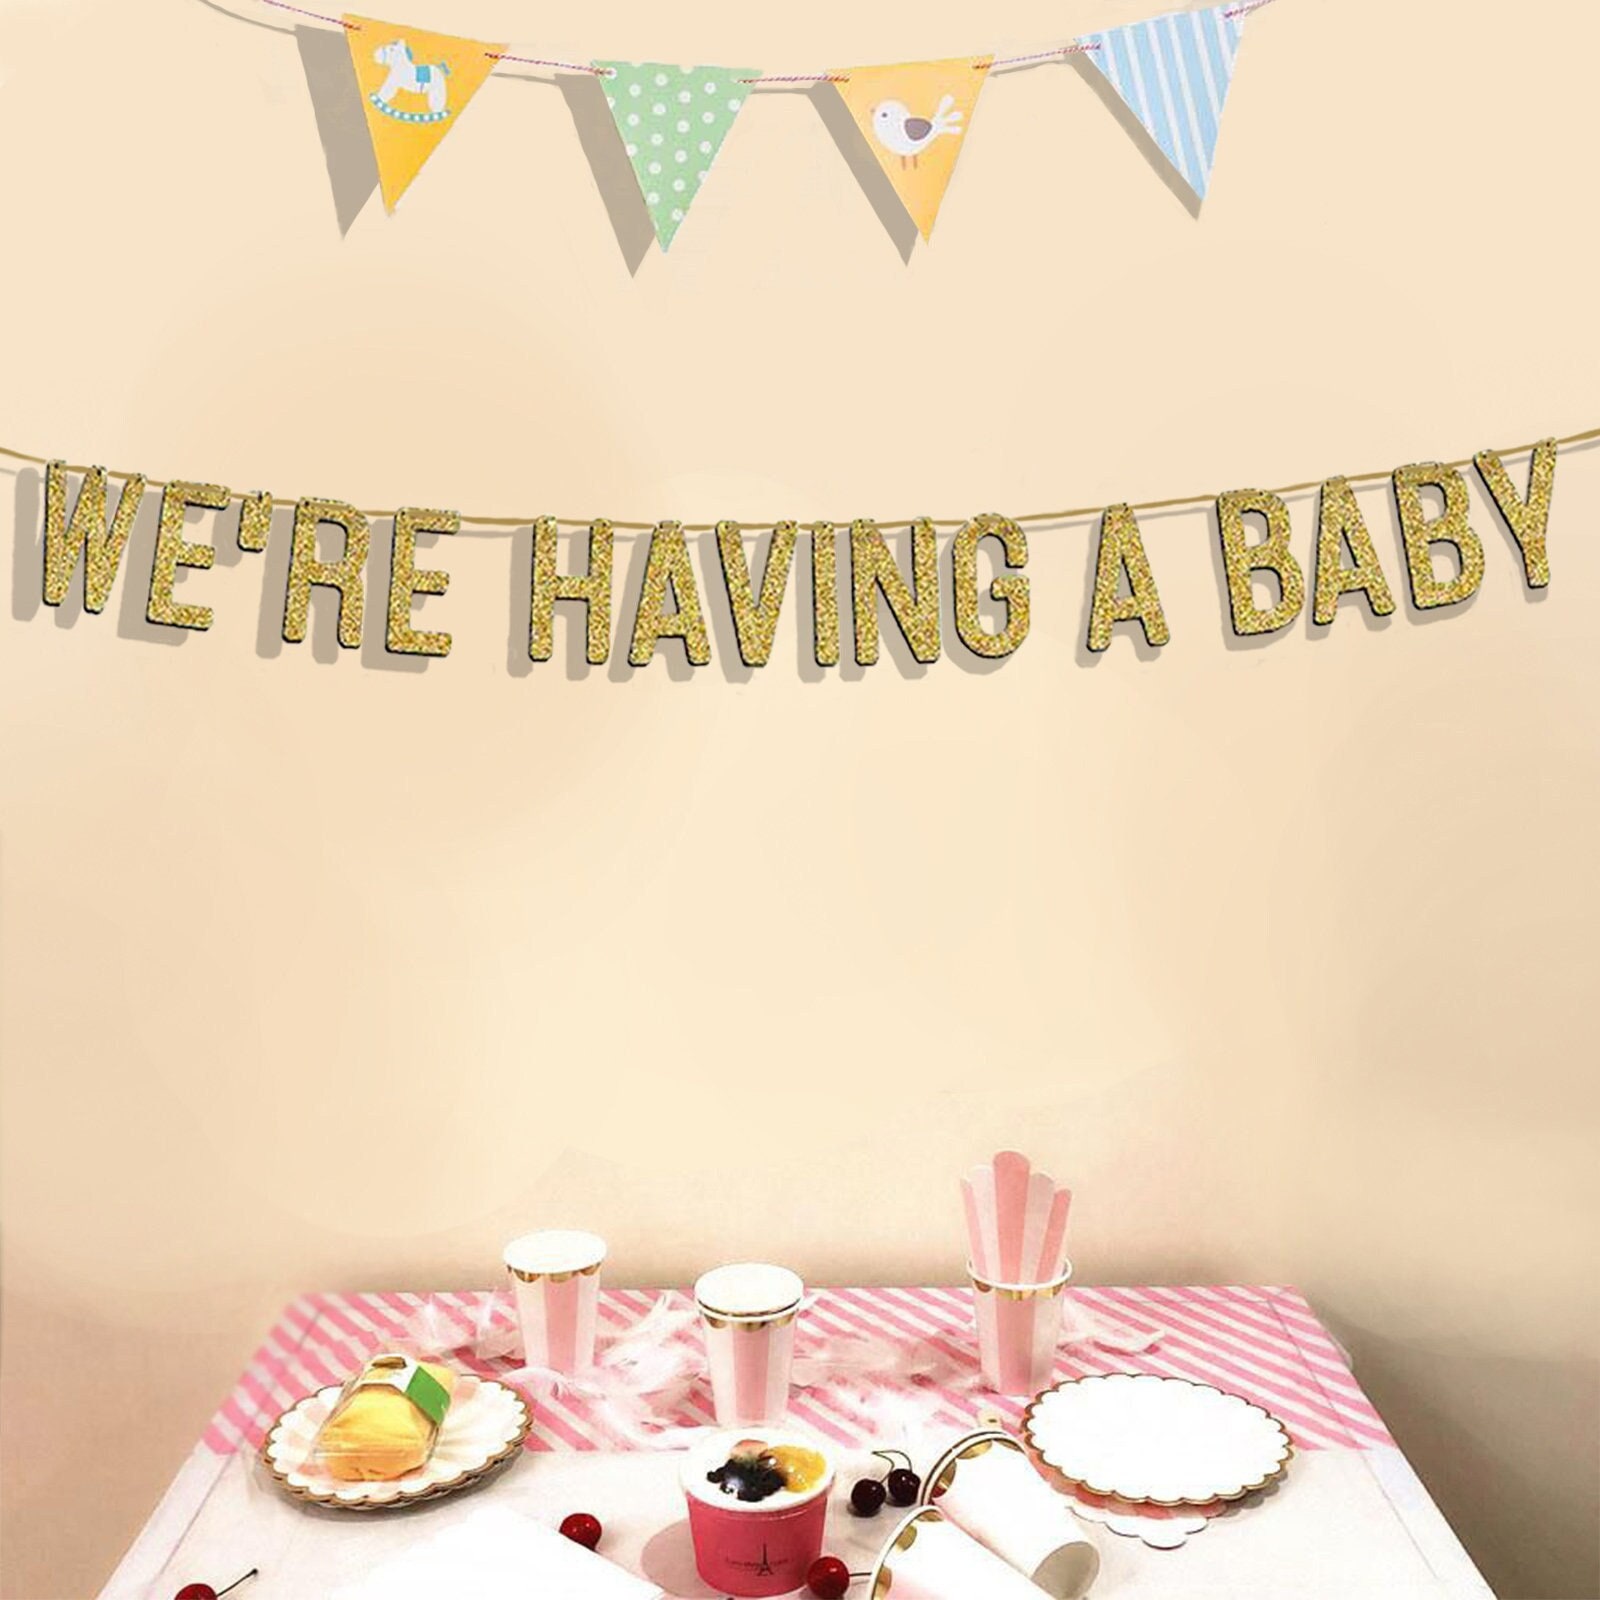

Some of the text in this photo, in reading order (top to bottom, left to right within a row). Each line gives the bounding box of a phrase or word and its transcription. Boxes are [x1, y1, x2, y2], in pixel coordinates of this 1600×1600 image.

[42, 437, 1558, 667] WE'RE HAVING A BABY
